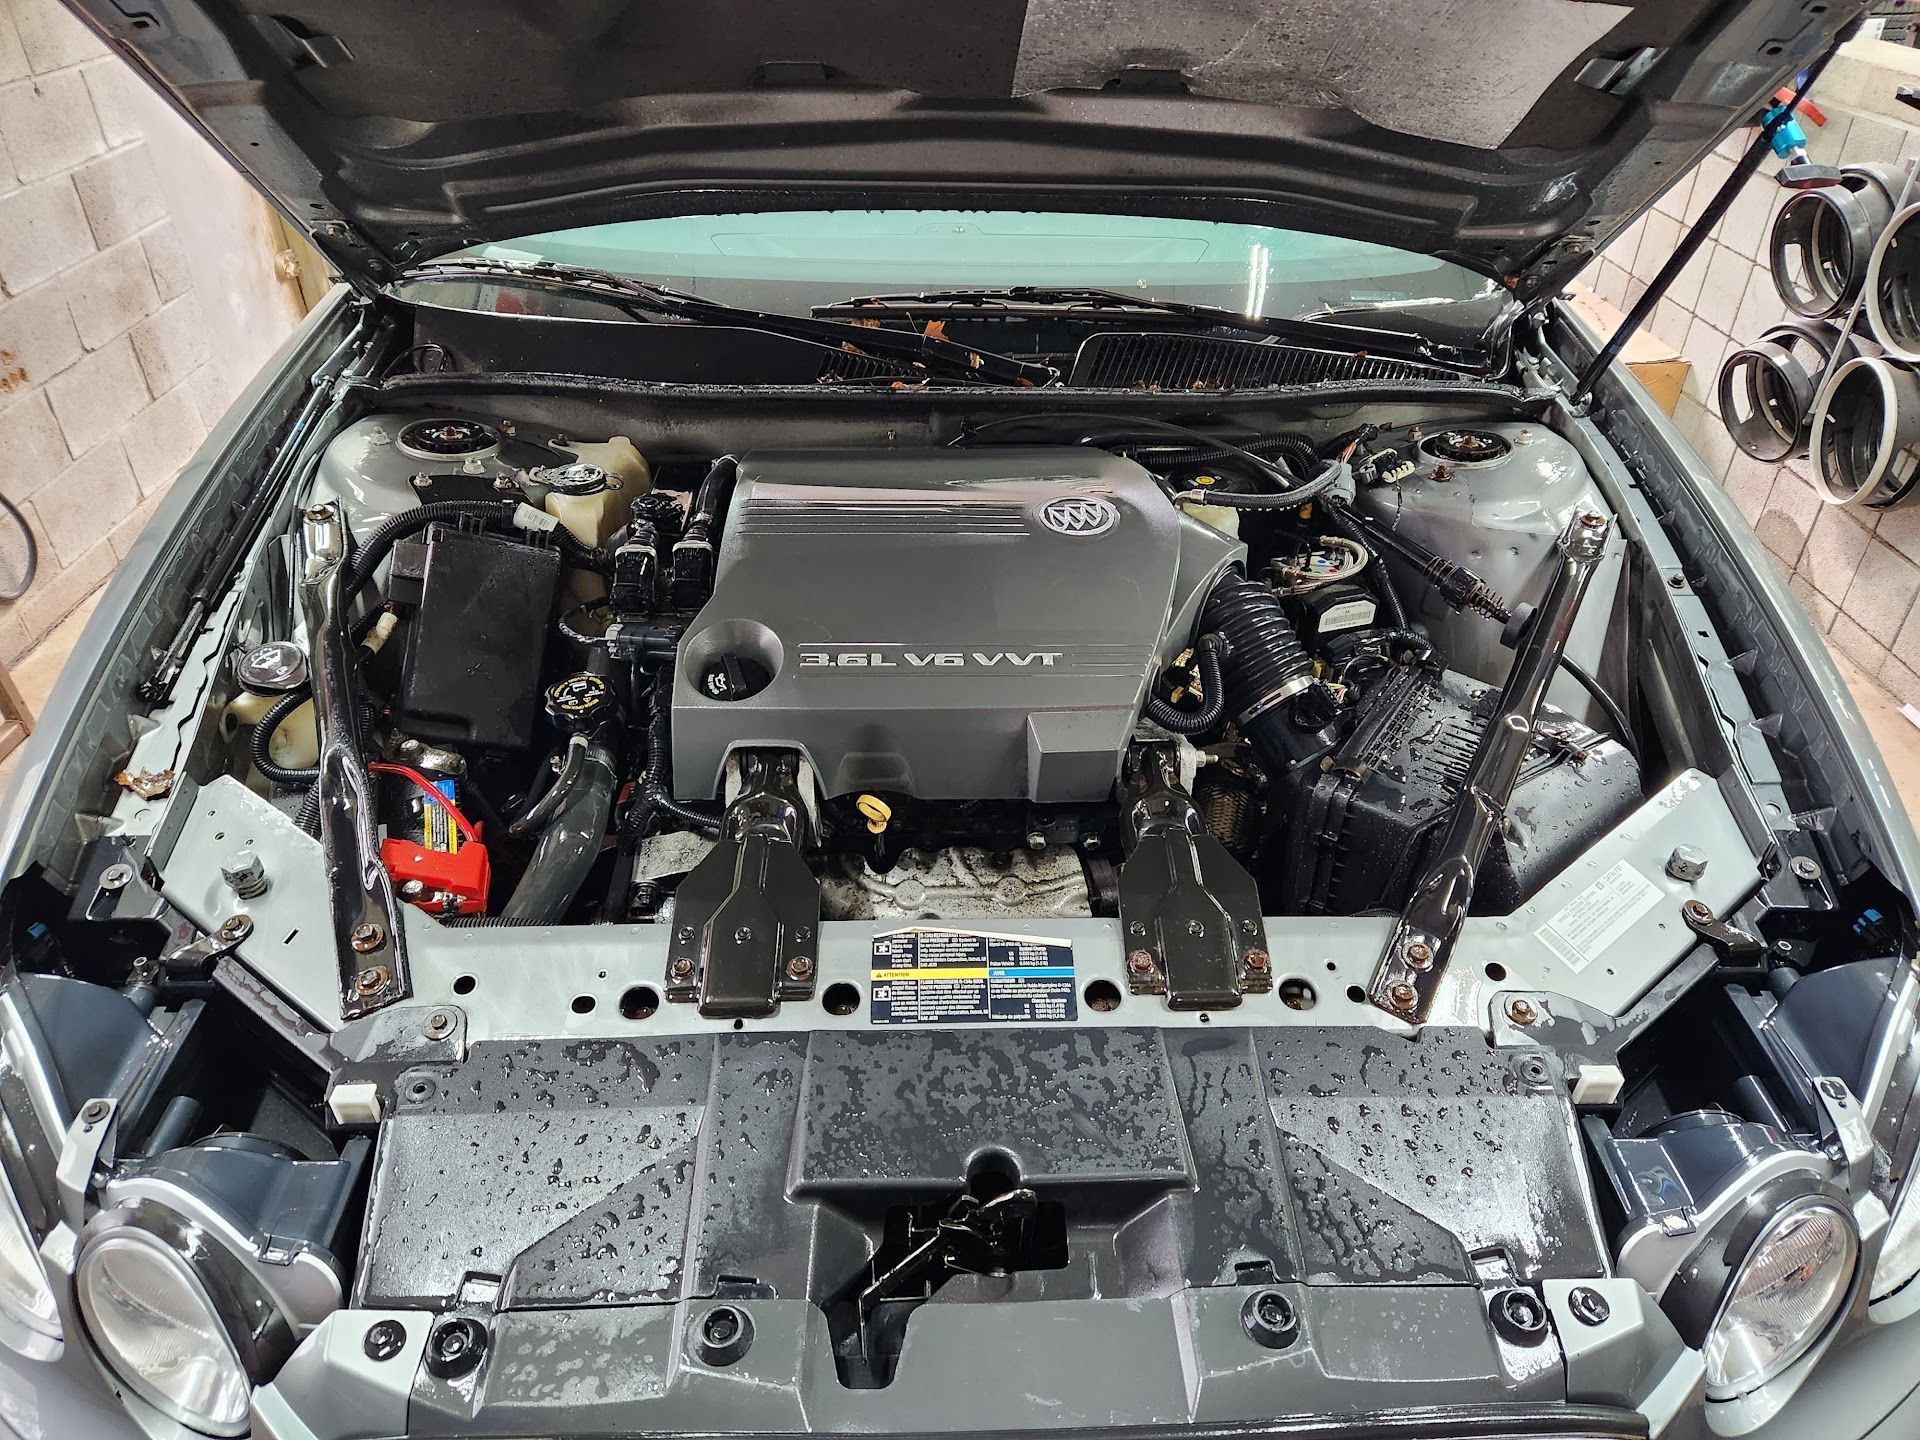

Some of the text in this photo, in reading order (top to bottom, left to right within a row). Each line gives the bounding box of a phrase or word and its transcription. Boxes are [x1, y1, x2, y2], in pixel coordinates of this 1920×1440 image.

[799, 652, 1063, 667] 3.6L V6 VVT
